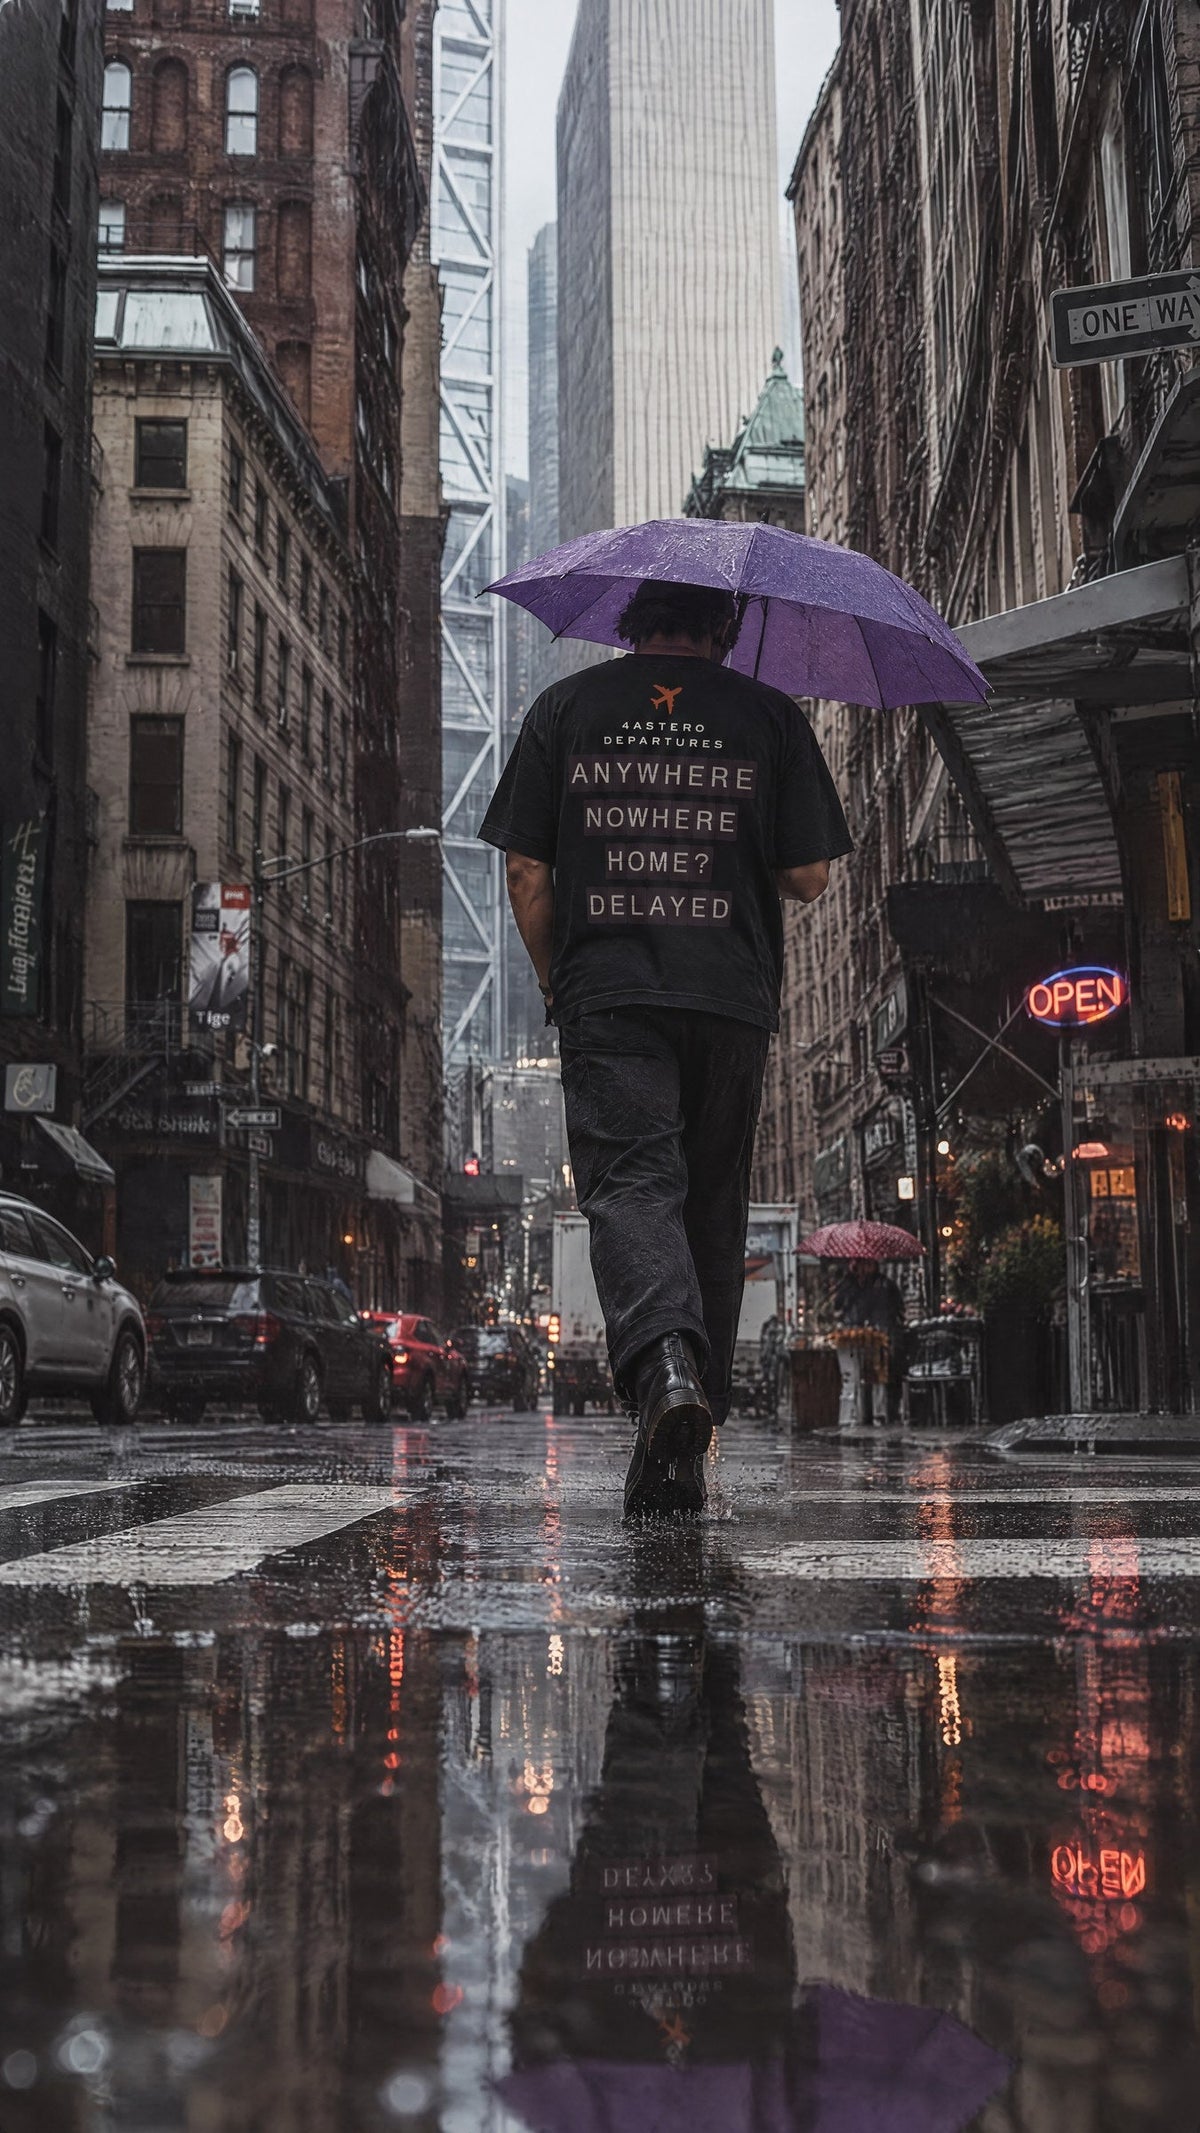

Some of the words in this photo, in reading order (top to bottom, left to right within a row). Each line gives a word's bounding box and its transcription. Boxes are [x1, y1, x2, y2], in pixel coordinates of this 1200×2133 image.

[1082, 304, 1140, 337] ONE
[621, 721, 706, 732] 4ASTERO
[603, 735, 724, 749] DEPARTURES
[571, 761, 754, 790] ANYWHERE
[585, 806, 736, 833] NOWHERE
[607, 850, 710, 874] HOME?
[590, 894, 729, 919] DELAYED
[1029, 975, 1121, 1017] OPEN
